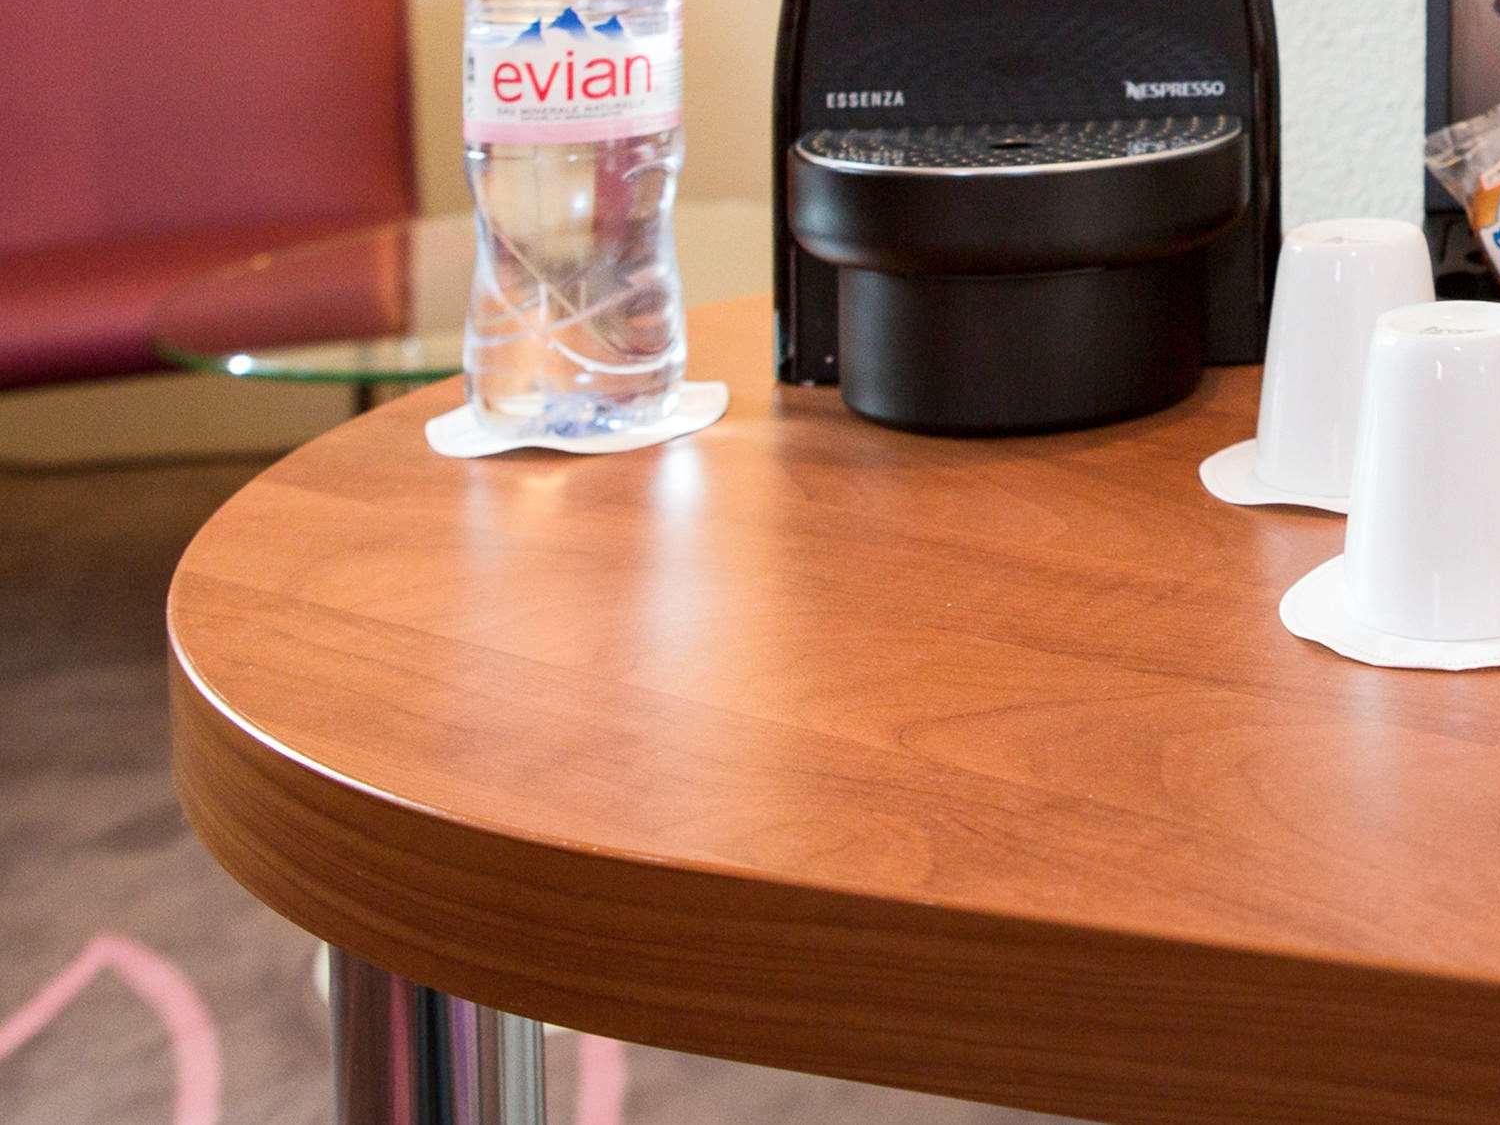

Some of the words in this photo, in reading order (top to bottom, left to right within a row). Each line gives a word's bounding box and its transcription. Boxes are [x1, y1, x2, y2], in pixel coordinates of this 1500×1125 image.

[493, 49, 653, 103] evian
[826, 91, 905, 109] ESSENZA
[1125, 80, 1226, 101] NESPRESSO
